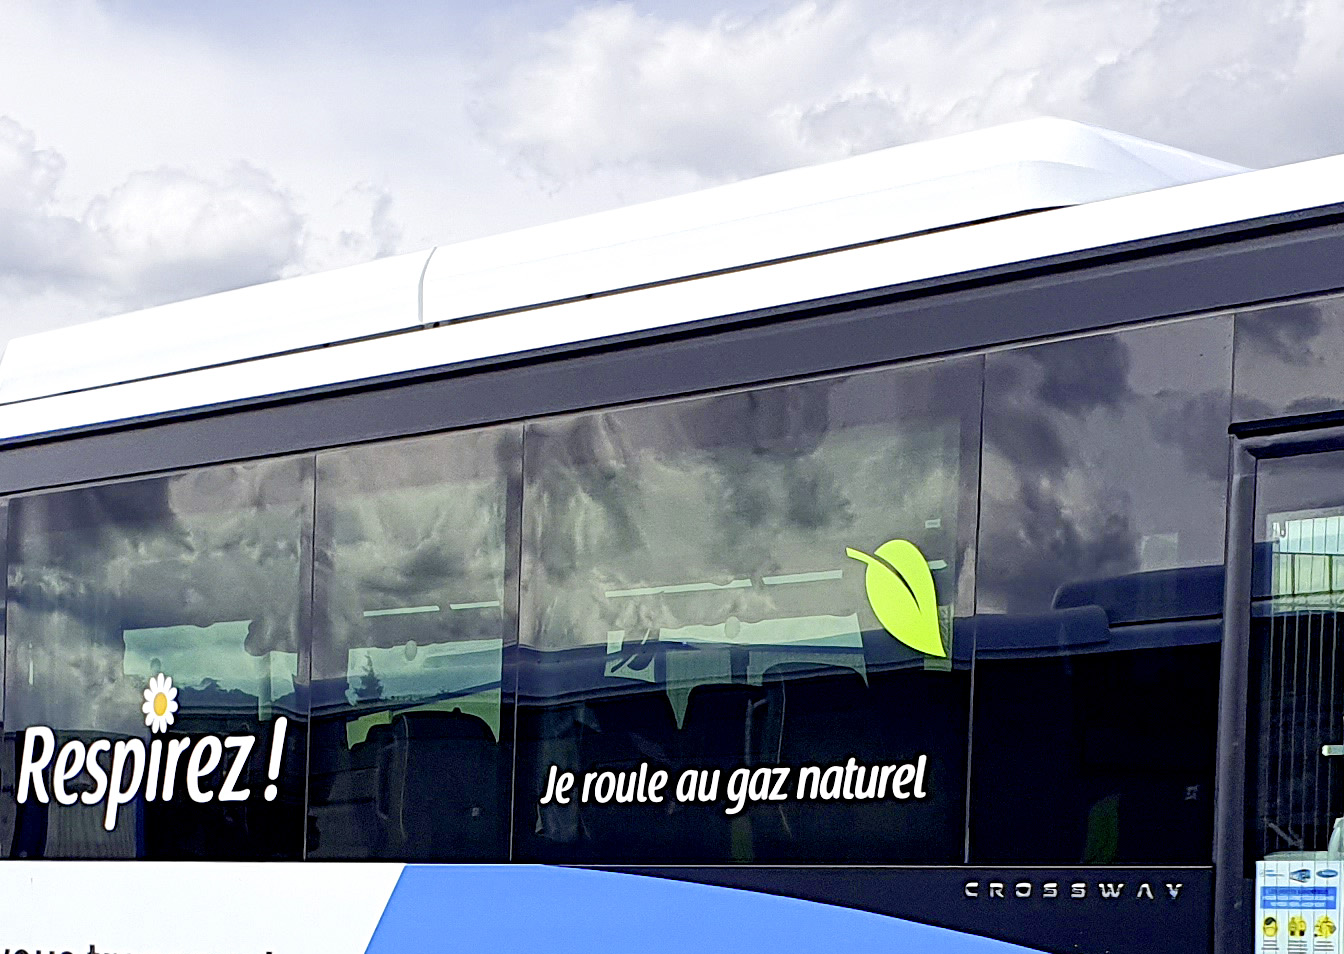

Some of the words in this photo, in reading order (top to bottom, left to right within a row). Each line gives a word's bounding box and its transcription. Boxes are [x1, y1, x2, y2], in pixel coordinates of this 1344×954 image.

[17, 726, 255, 831] Respirez
[540, 765, 575, 803] Je
[581, 762, 668, 803] roule
[676, 769, 720, 802] au
[725, 768, 791, 815] gaz
[796, 754, 927, 800] naturel
[964, 881, 1183, 900] CROSSWAY
